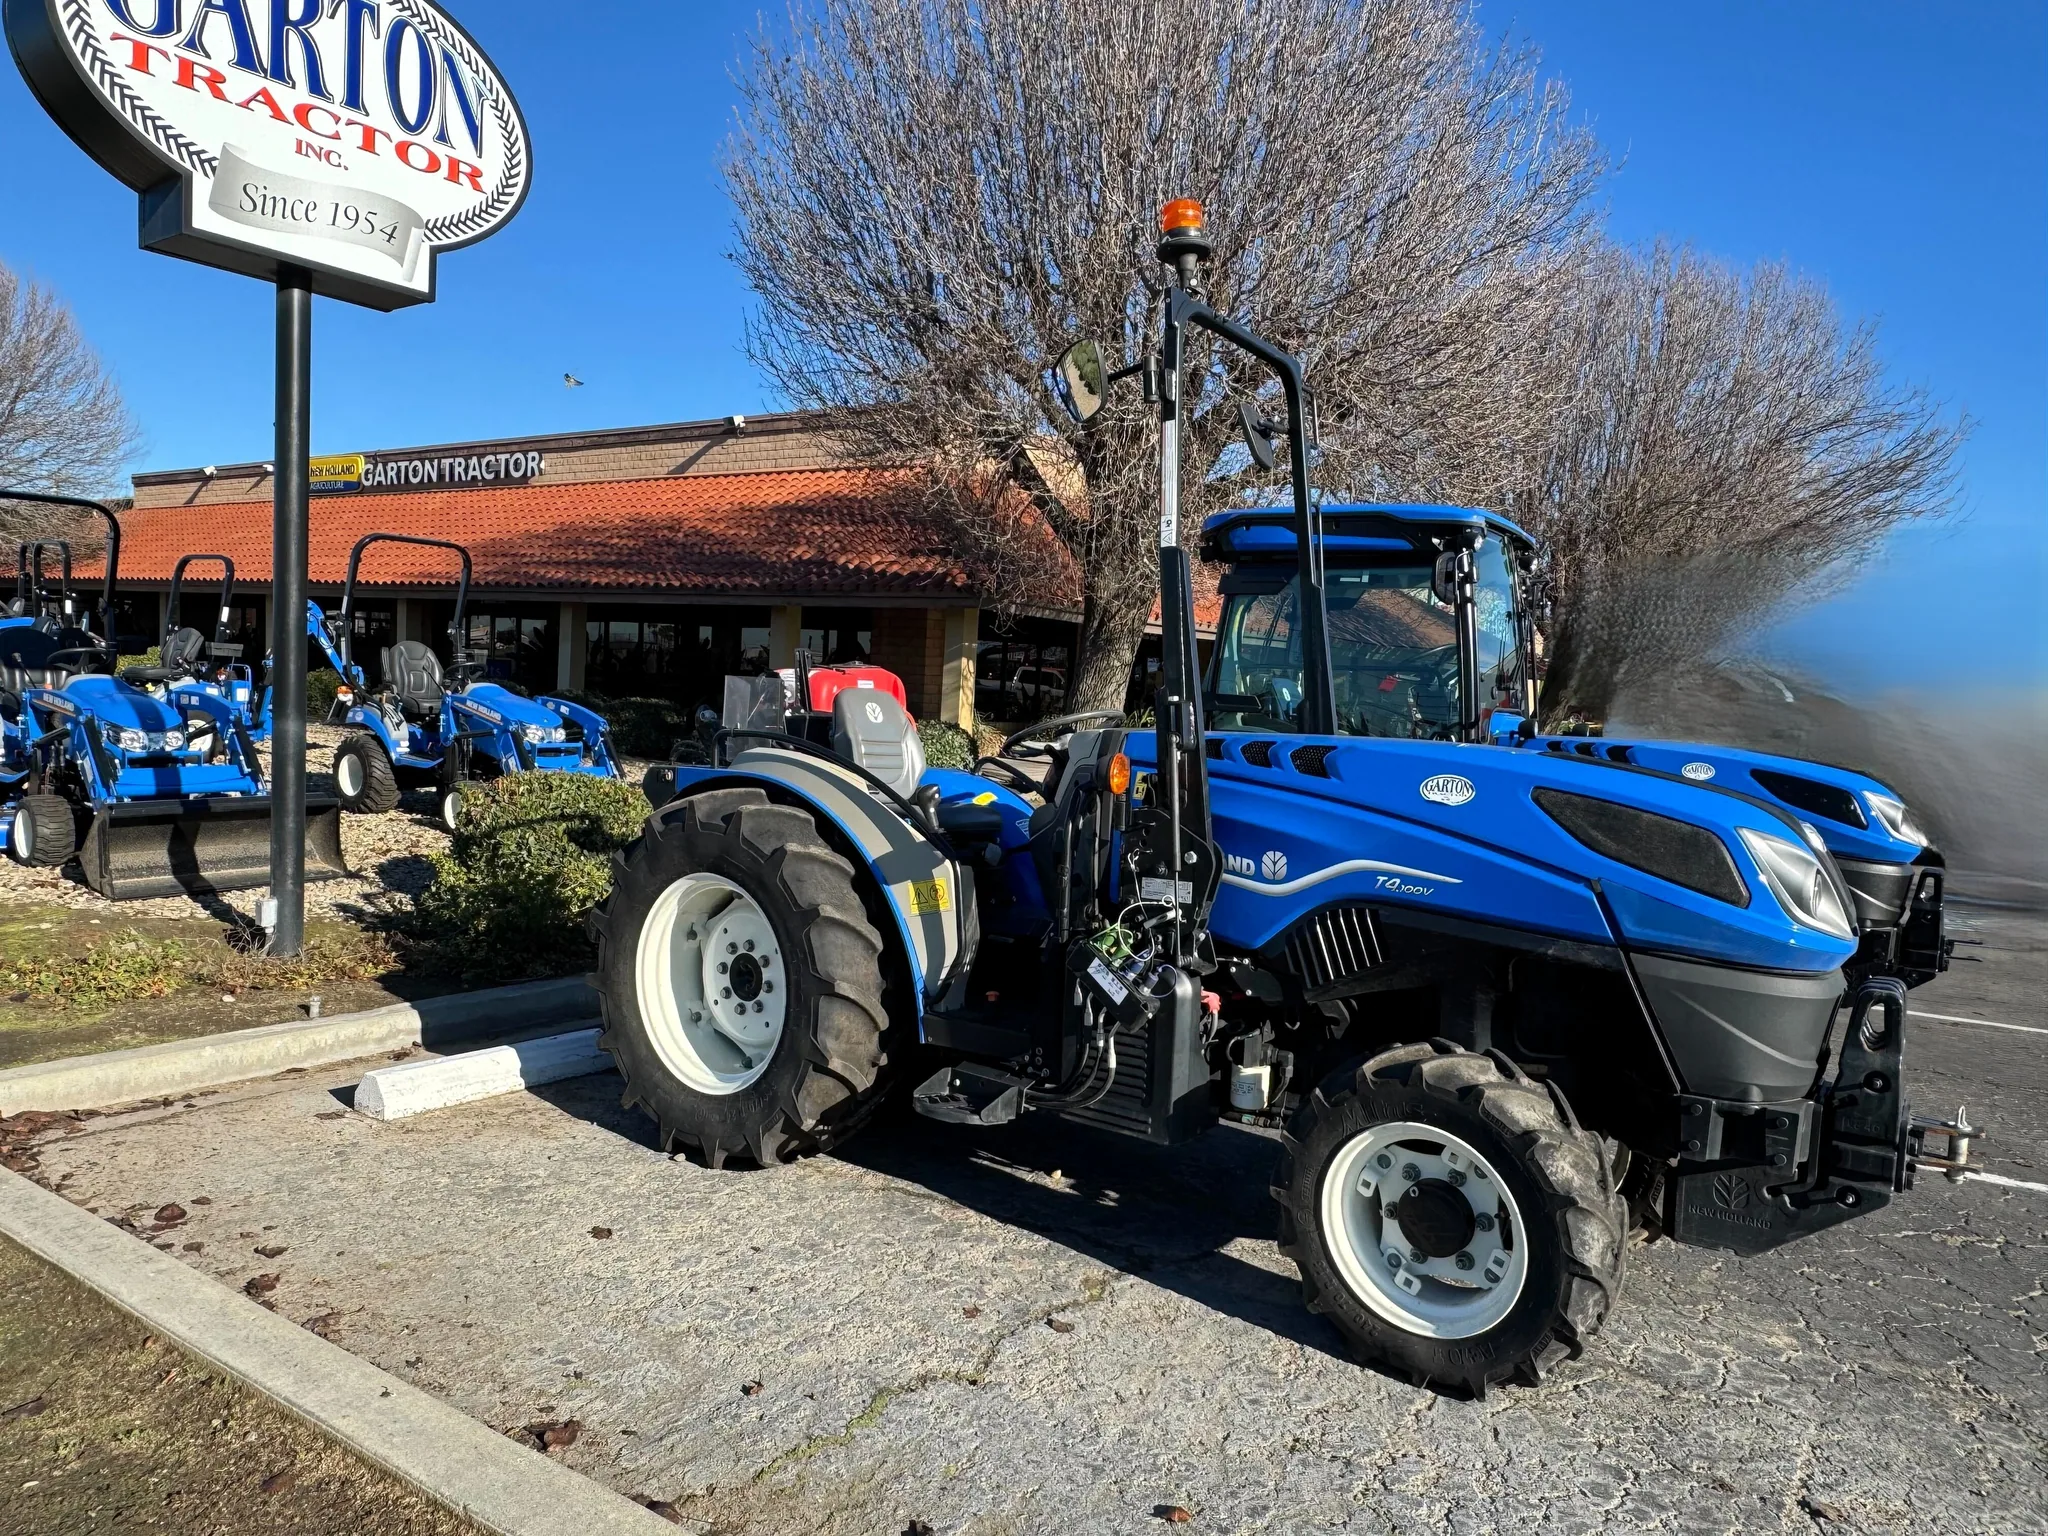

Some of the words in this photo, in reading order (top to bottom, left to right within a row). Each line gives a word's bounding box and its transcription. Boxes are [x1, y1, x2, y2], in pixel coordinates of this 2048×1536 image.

[110, 32, 487, 194] TRACTOR
[295, 138, 349, 170] INC.
[239, 182, 317, 223] Since
[326, 202, 399, 246] 1954
[325, 464, 356, 476] HOLLAND
[361, 459, 443, 486] GARTON
[441, 451, 540, 483] TRACTOR
[1424, 778, 1475, 796] GARTON
[1688, 1204, 1715, 1218] NEW
[1717, 1209, 1772, 1230] HOLLAND
